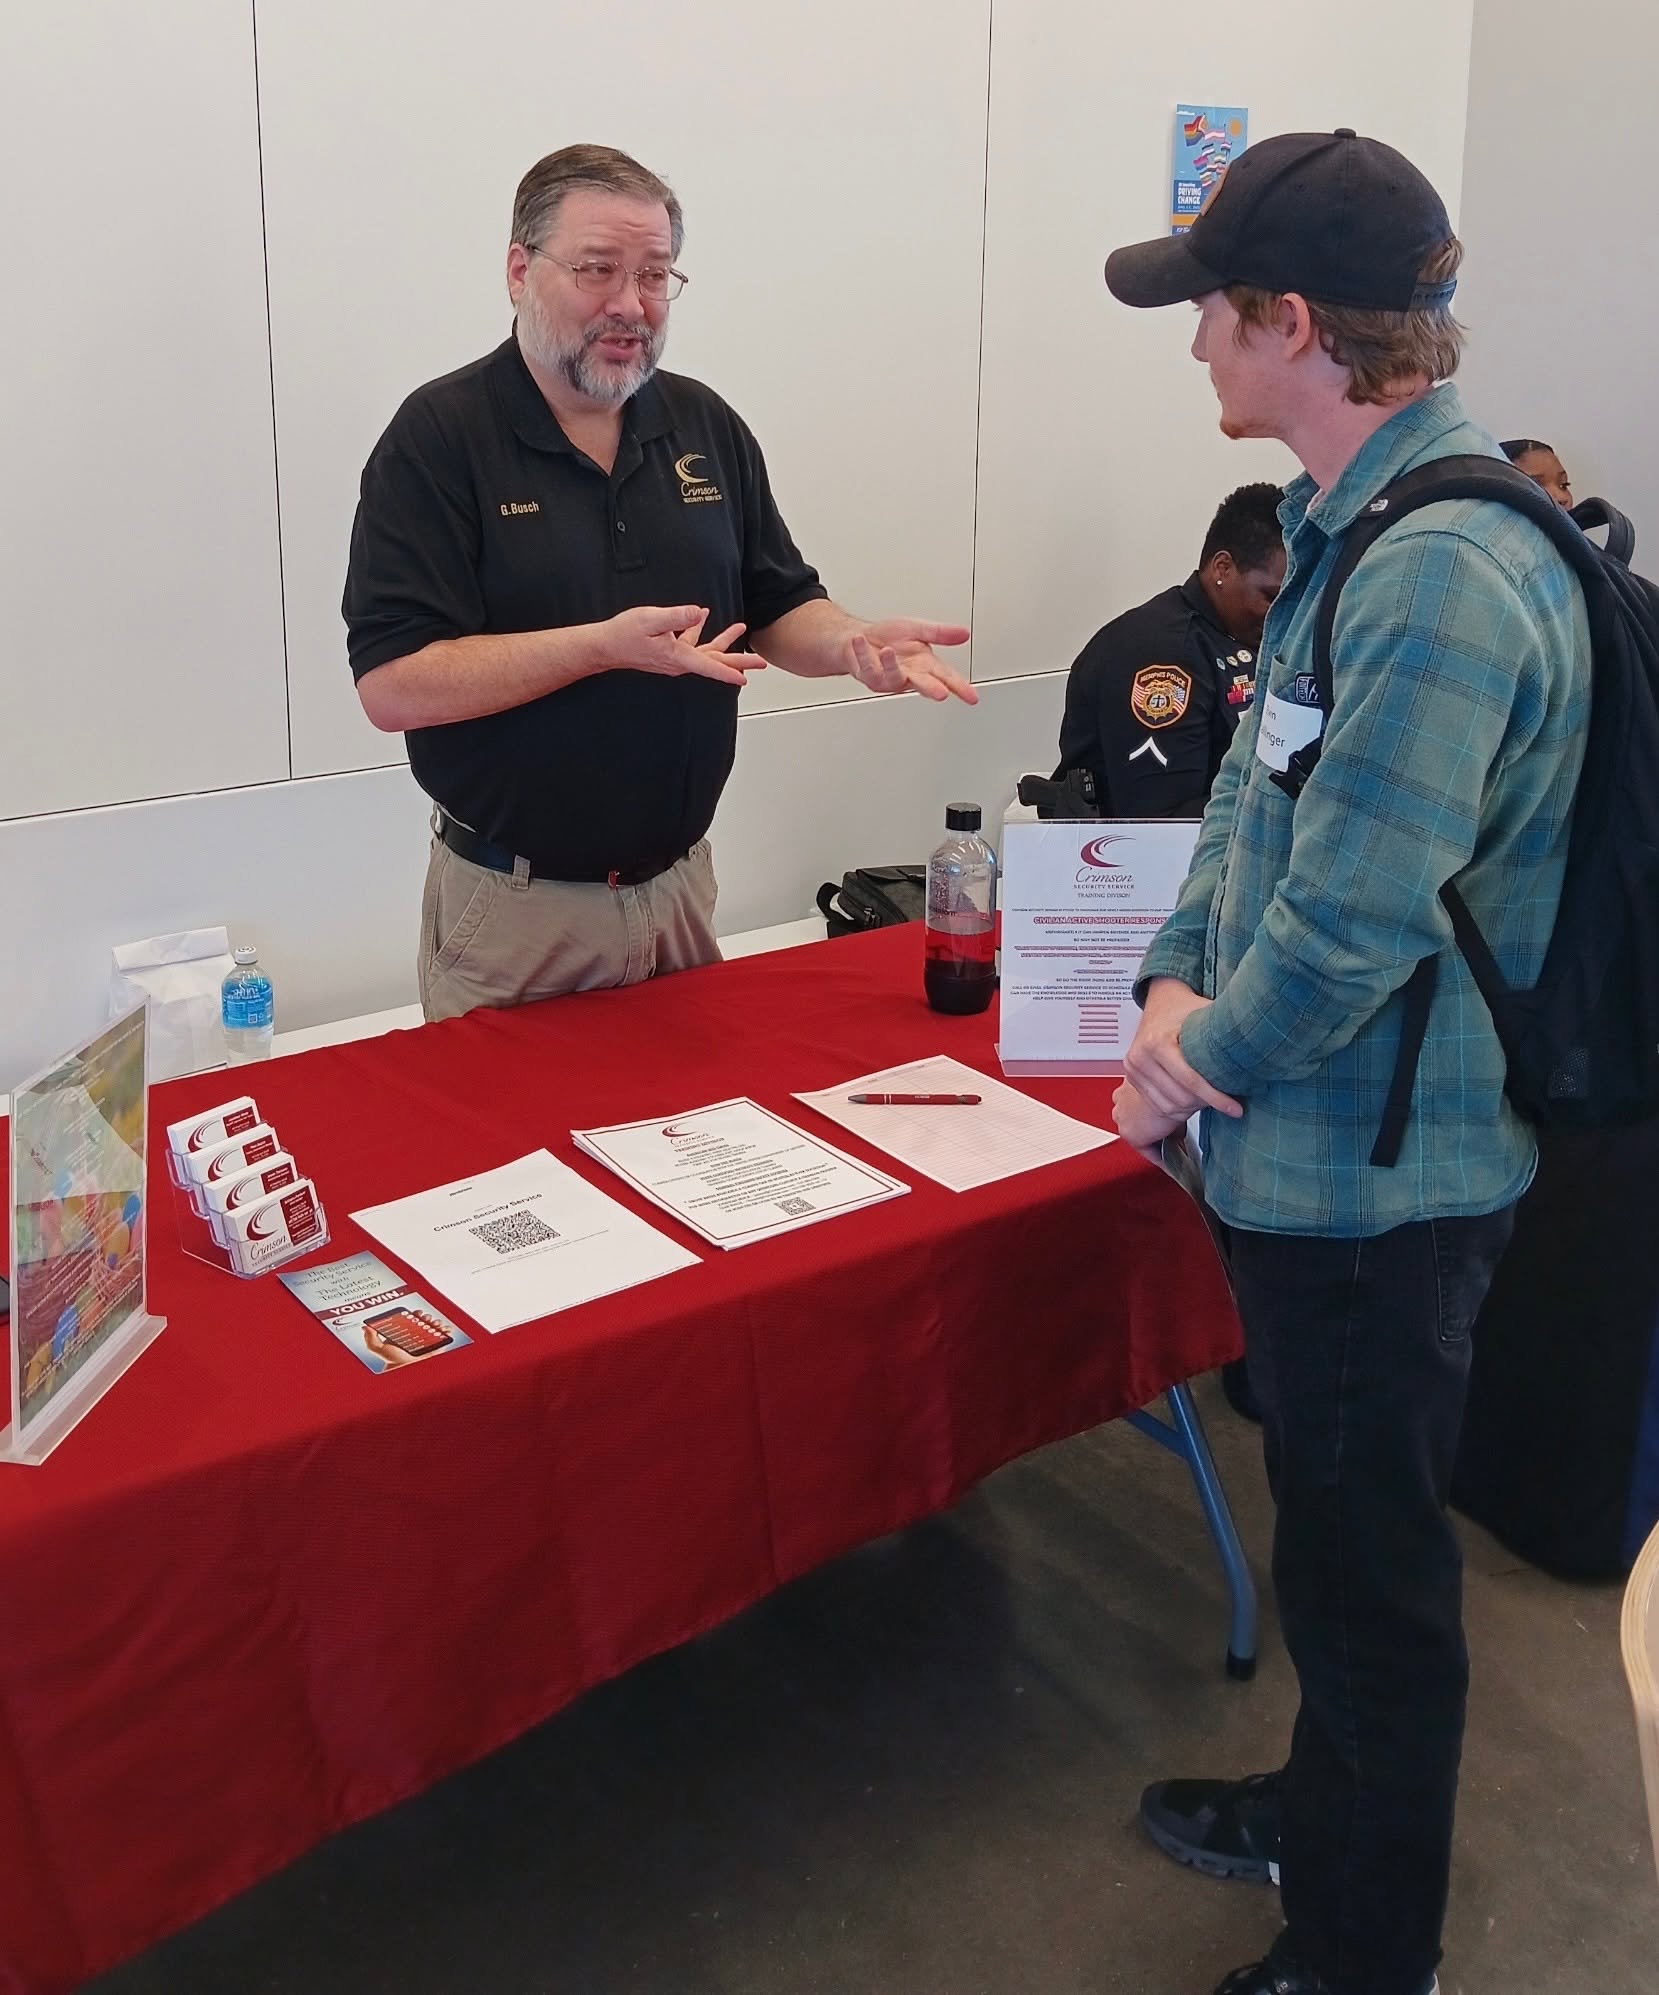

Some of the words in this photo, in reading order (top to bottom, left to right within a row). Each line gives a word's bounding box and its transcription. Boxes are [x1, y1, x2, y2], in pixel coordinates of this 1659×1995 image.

[1178, 187, 1201, 196] DRIVING
[1178, 196, 1200, 205] CHANGE
[681, 481, 719, 497] Crimson
[500, 500, 540, 516] G.Busch
[1166, 671, 1187, 689] POLICE
[1075, 866, 1134, 883] Crimson
[1034, 916, 1066, 925] CIVILIAN
[1065, 916, 1093, 925] ACTIVE
[1094, 916, 1130, 925] SHOOTER
[433, 1216, 472, 1232] Crimson
[473, 1204, 509, 1220] Security
[509, 1192, 543, 1208] Service
[250, 1235, 287, 1261] Crimson
[335, 1262, 372, 1276] Service
[320, 1280, 381, 1301] Technology
[339, 1276, 375, 1290] Latest
[329, 1302, 365, 1315] YOU
[365, 1290, 404, 1305] WIN.
